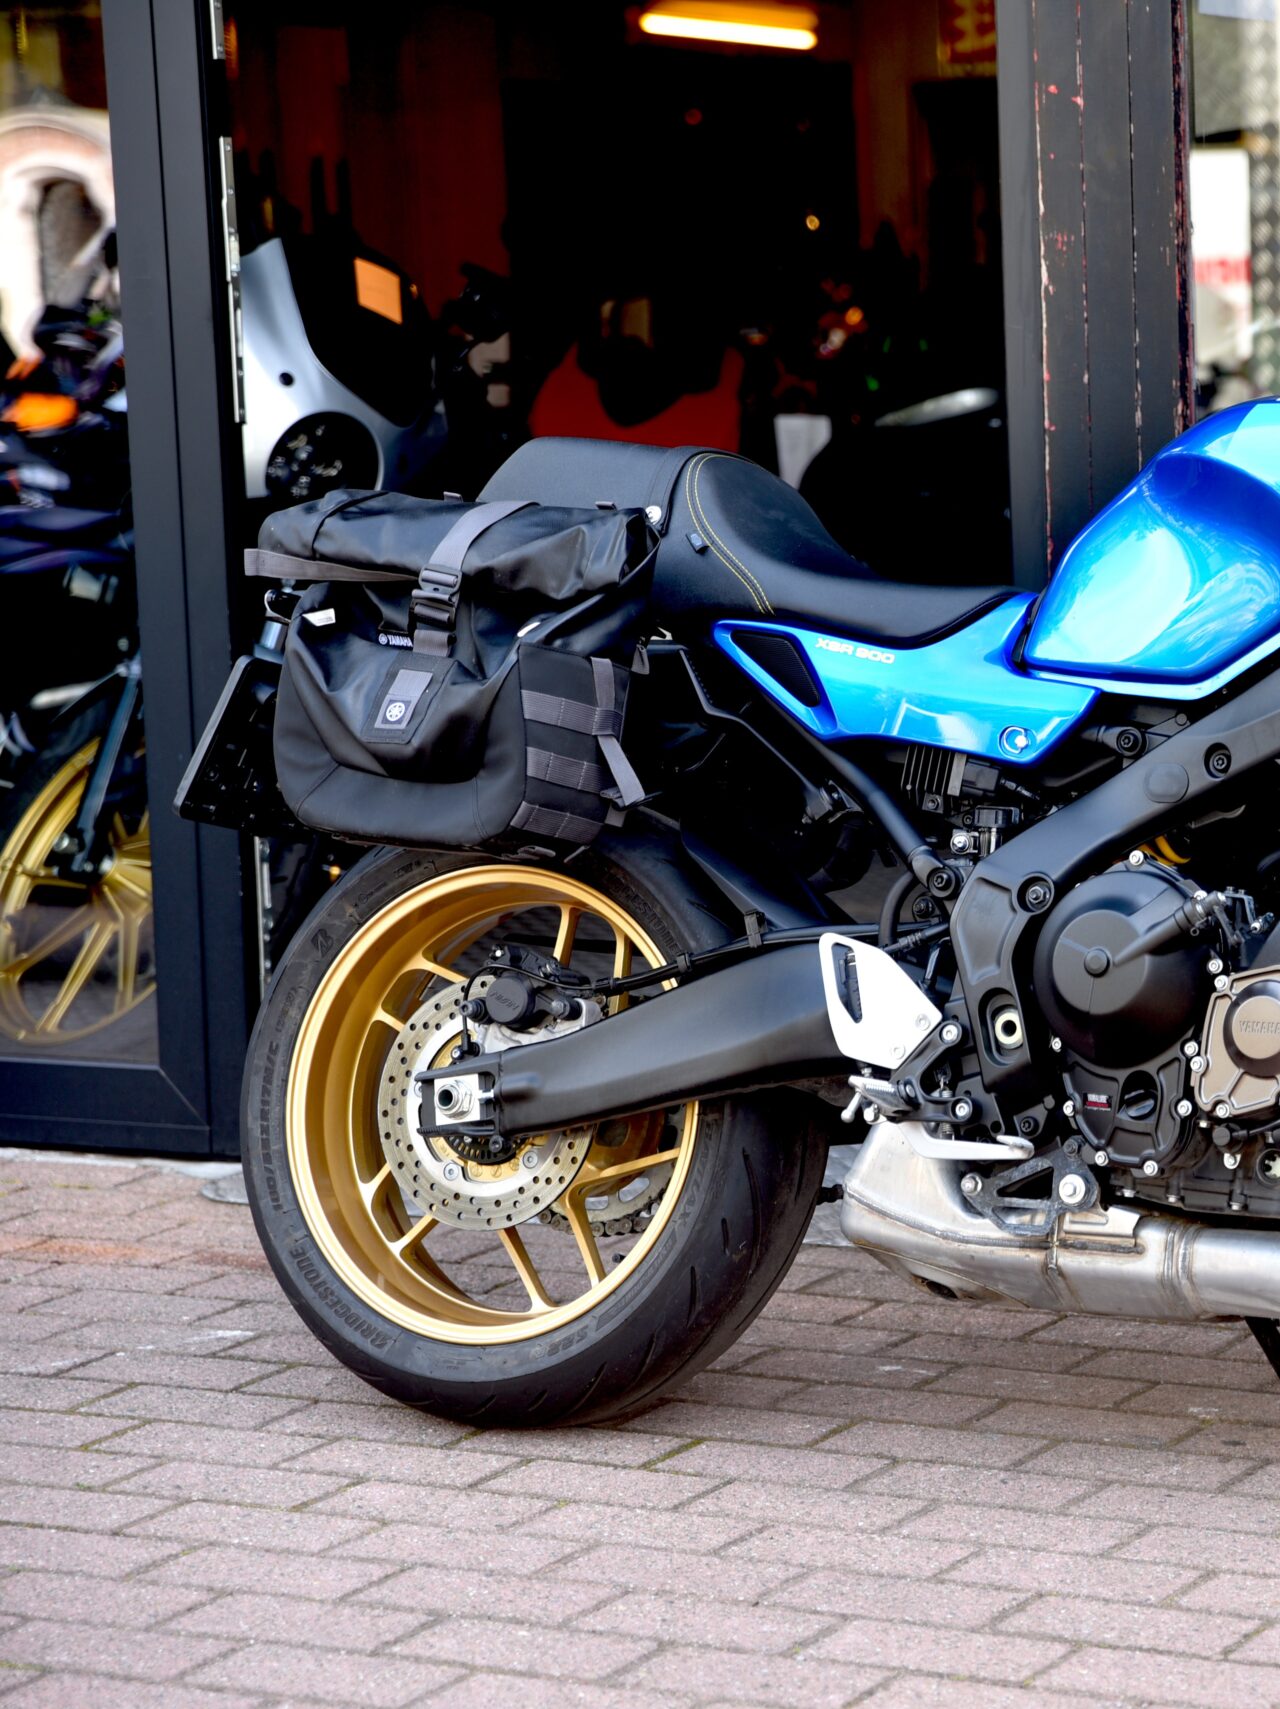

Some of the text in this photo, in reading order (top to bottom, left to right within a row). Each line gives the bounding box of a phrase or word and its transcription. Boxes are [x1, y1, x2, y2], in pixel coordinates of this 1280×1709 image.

[815, 637, 896, 664] XSR 900
[1239, 1020, 1280, 1035] YAMAHA
[288, 1246, 390, 1350] BRIDGESTONE
